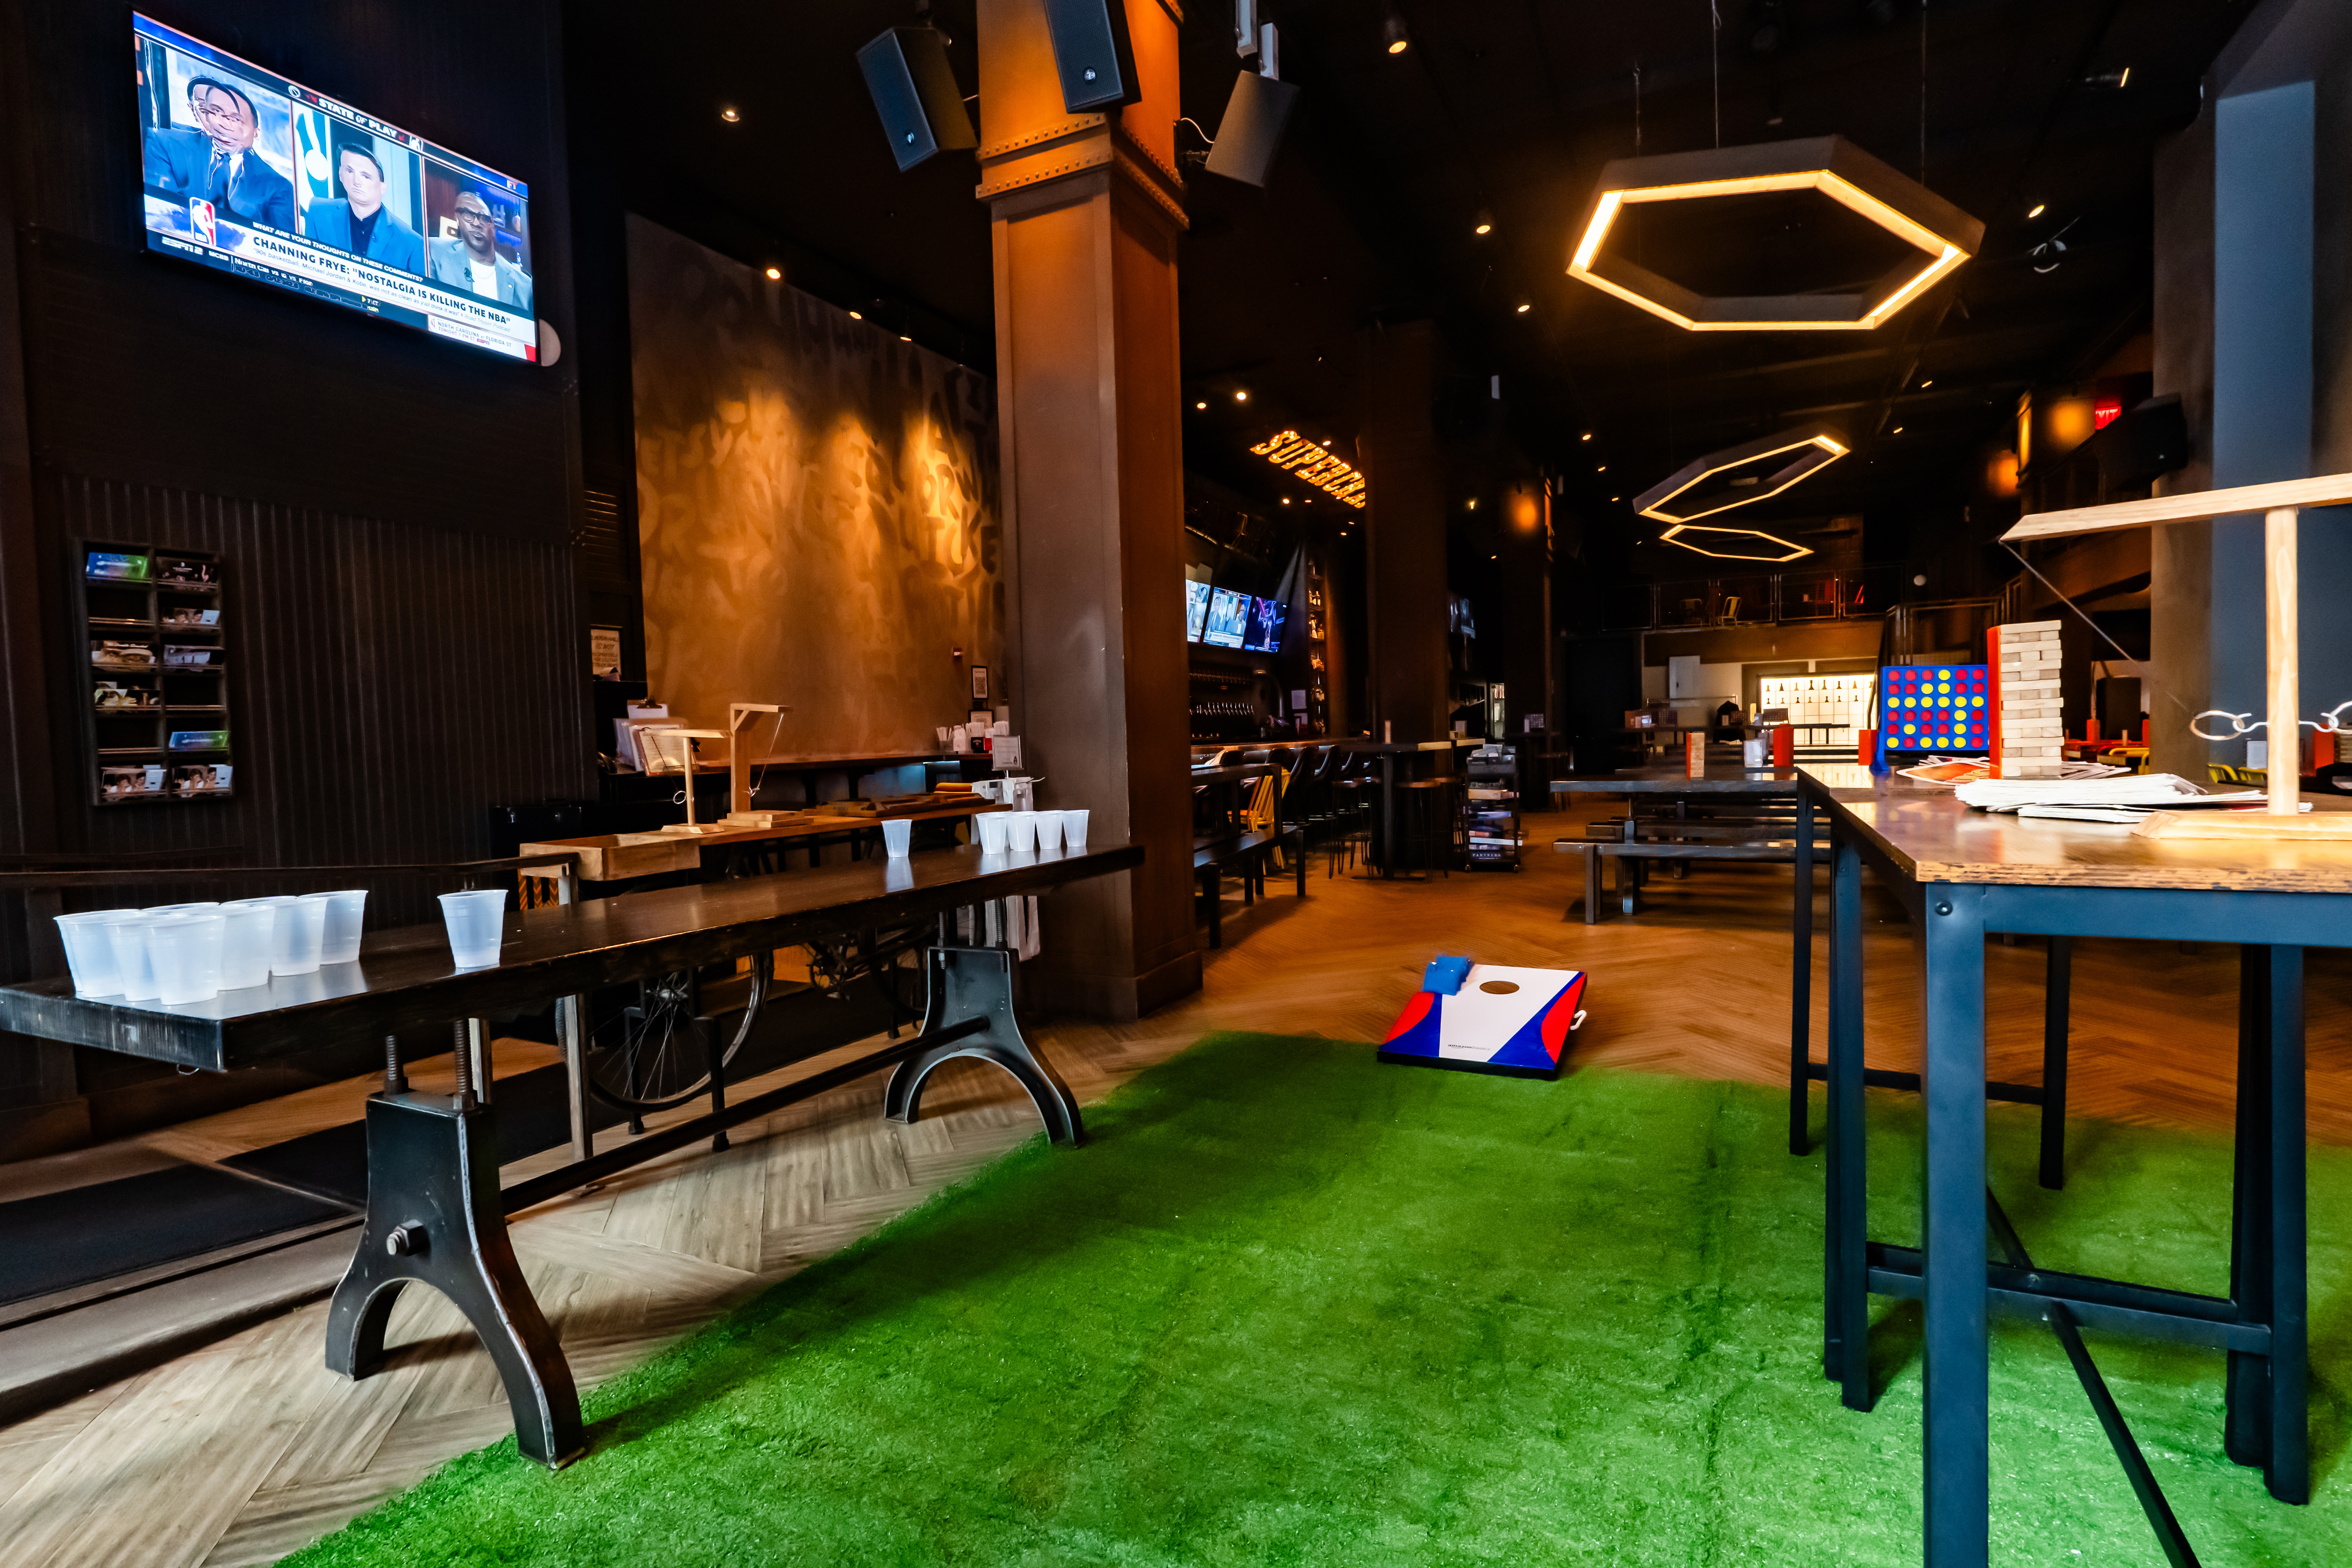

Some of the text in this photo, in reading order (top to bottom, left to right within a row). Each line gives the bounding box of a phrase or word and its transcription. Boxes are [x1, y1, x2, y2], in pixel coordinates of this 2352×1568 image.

[319, 98, 397, 138] STATE OF PLAY
[253, 222, 423, 282] WHAT ARE YOUR THOUGHTS ON THESE COMMENTS?
[253, 237, 316, 264] CHANNING
[319, 257, 349, 274] FRYE:
[352, 268, 416, 295] "NOSTALGIA
[418, 289, 427, 298] IS
[430, 292, 466, 311] KILLING
[468, 305, 486, 317] THE
[488, 312, 511, 324] NBA"
[268, 251, 300, 267] basketball,
[302, 263, 325, 274] Michael
[326, 271, 345, 281] Jordan
[464, 313, 476, 322] Road
[493, 323, 511, 332] Podcast
[437, 321, 454, 330] NORTH
[456, 327, 479, 337] CAROLINA
[486, 336, 505, 345] FLORIDA
[438, 326, 457, 335] TONIGHT
